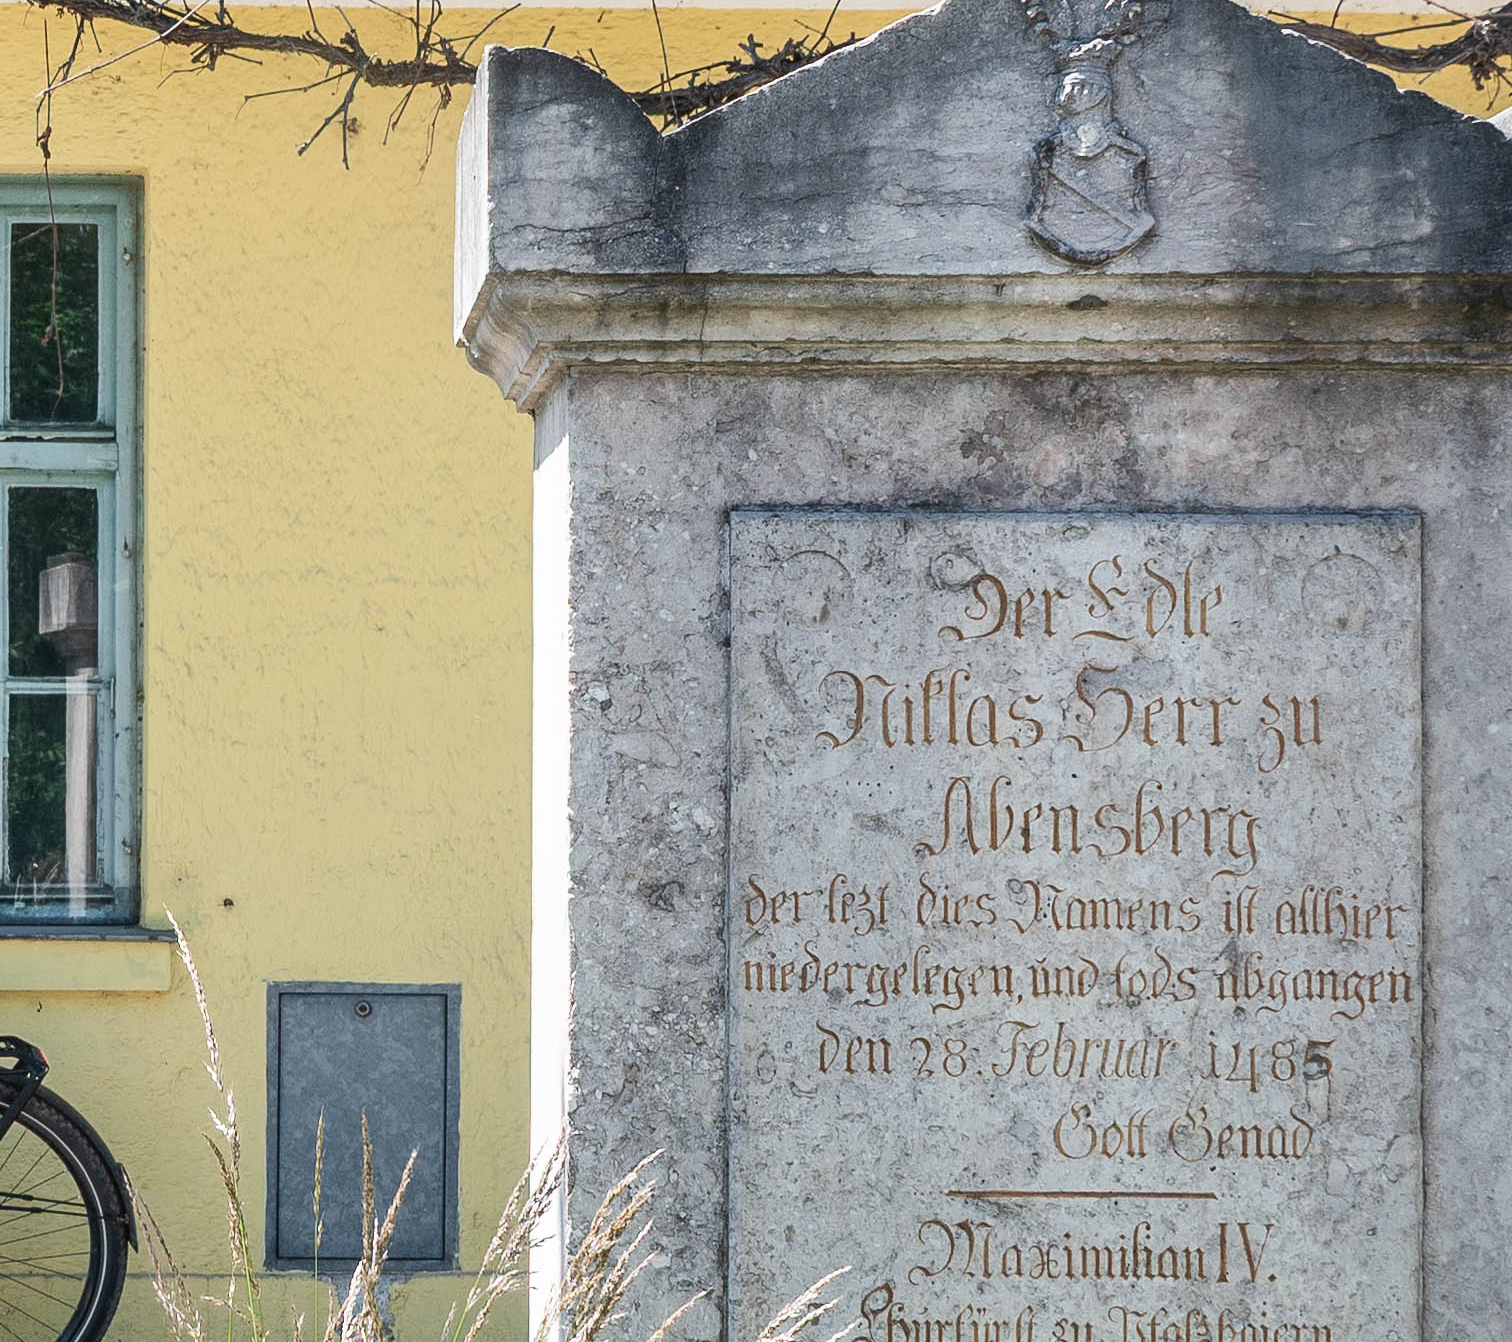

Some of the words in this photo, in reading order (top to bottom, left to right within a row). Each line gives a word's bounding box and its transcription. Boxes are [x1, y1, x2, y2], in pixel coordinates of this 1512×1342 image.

[937, 573, 1073, 642] Der
[1072, 555, 1223, 644] Edle
[815, 664, 1045, 751] Niklas
[1062, 662, 1242, 753] Herr
[1257, 692, 1329, 774] zu
[912, 774, 1261, 882] Abensberg
[744, 872, 815, 927] der
[915, 870, 998, 928] dies
[1006, 879, 1202, 935] Namens
[1215, 950, 1415, 1022] abgangen
[815, 1018, 893, 1076] den
[990, 1019, 1178, 1079] Februar
[1052, 1100, 1156, 1160] Gott
[1167, 1103, 1315, 1163] Genad
[907, 1218, 1208, 1287] Maximilian
[1215, 1221, 1278, 1285] IV.
